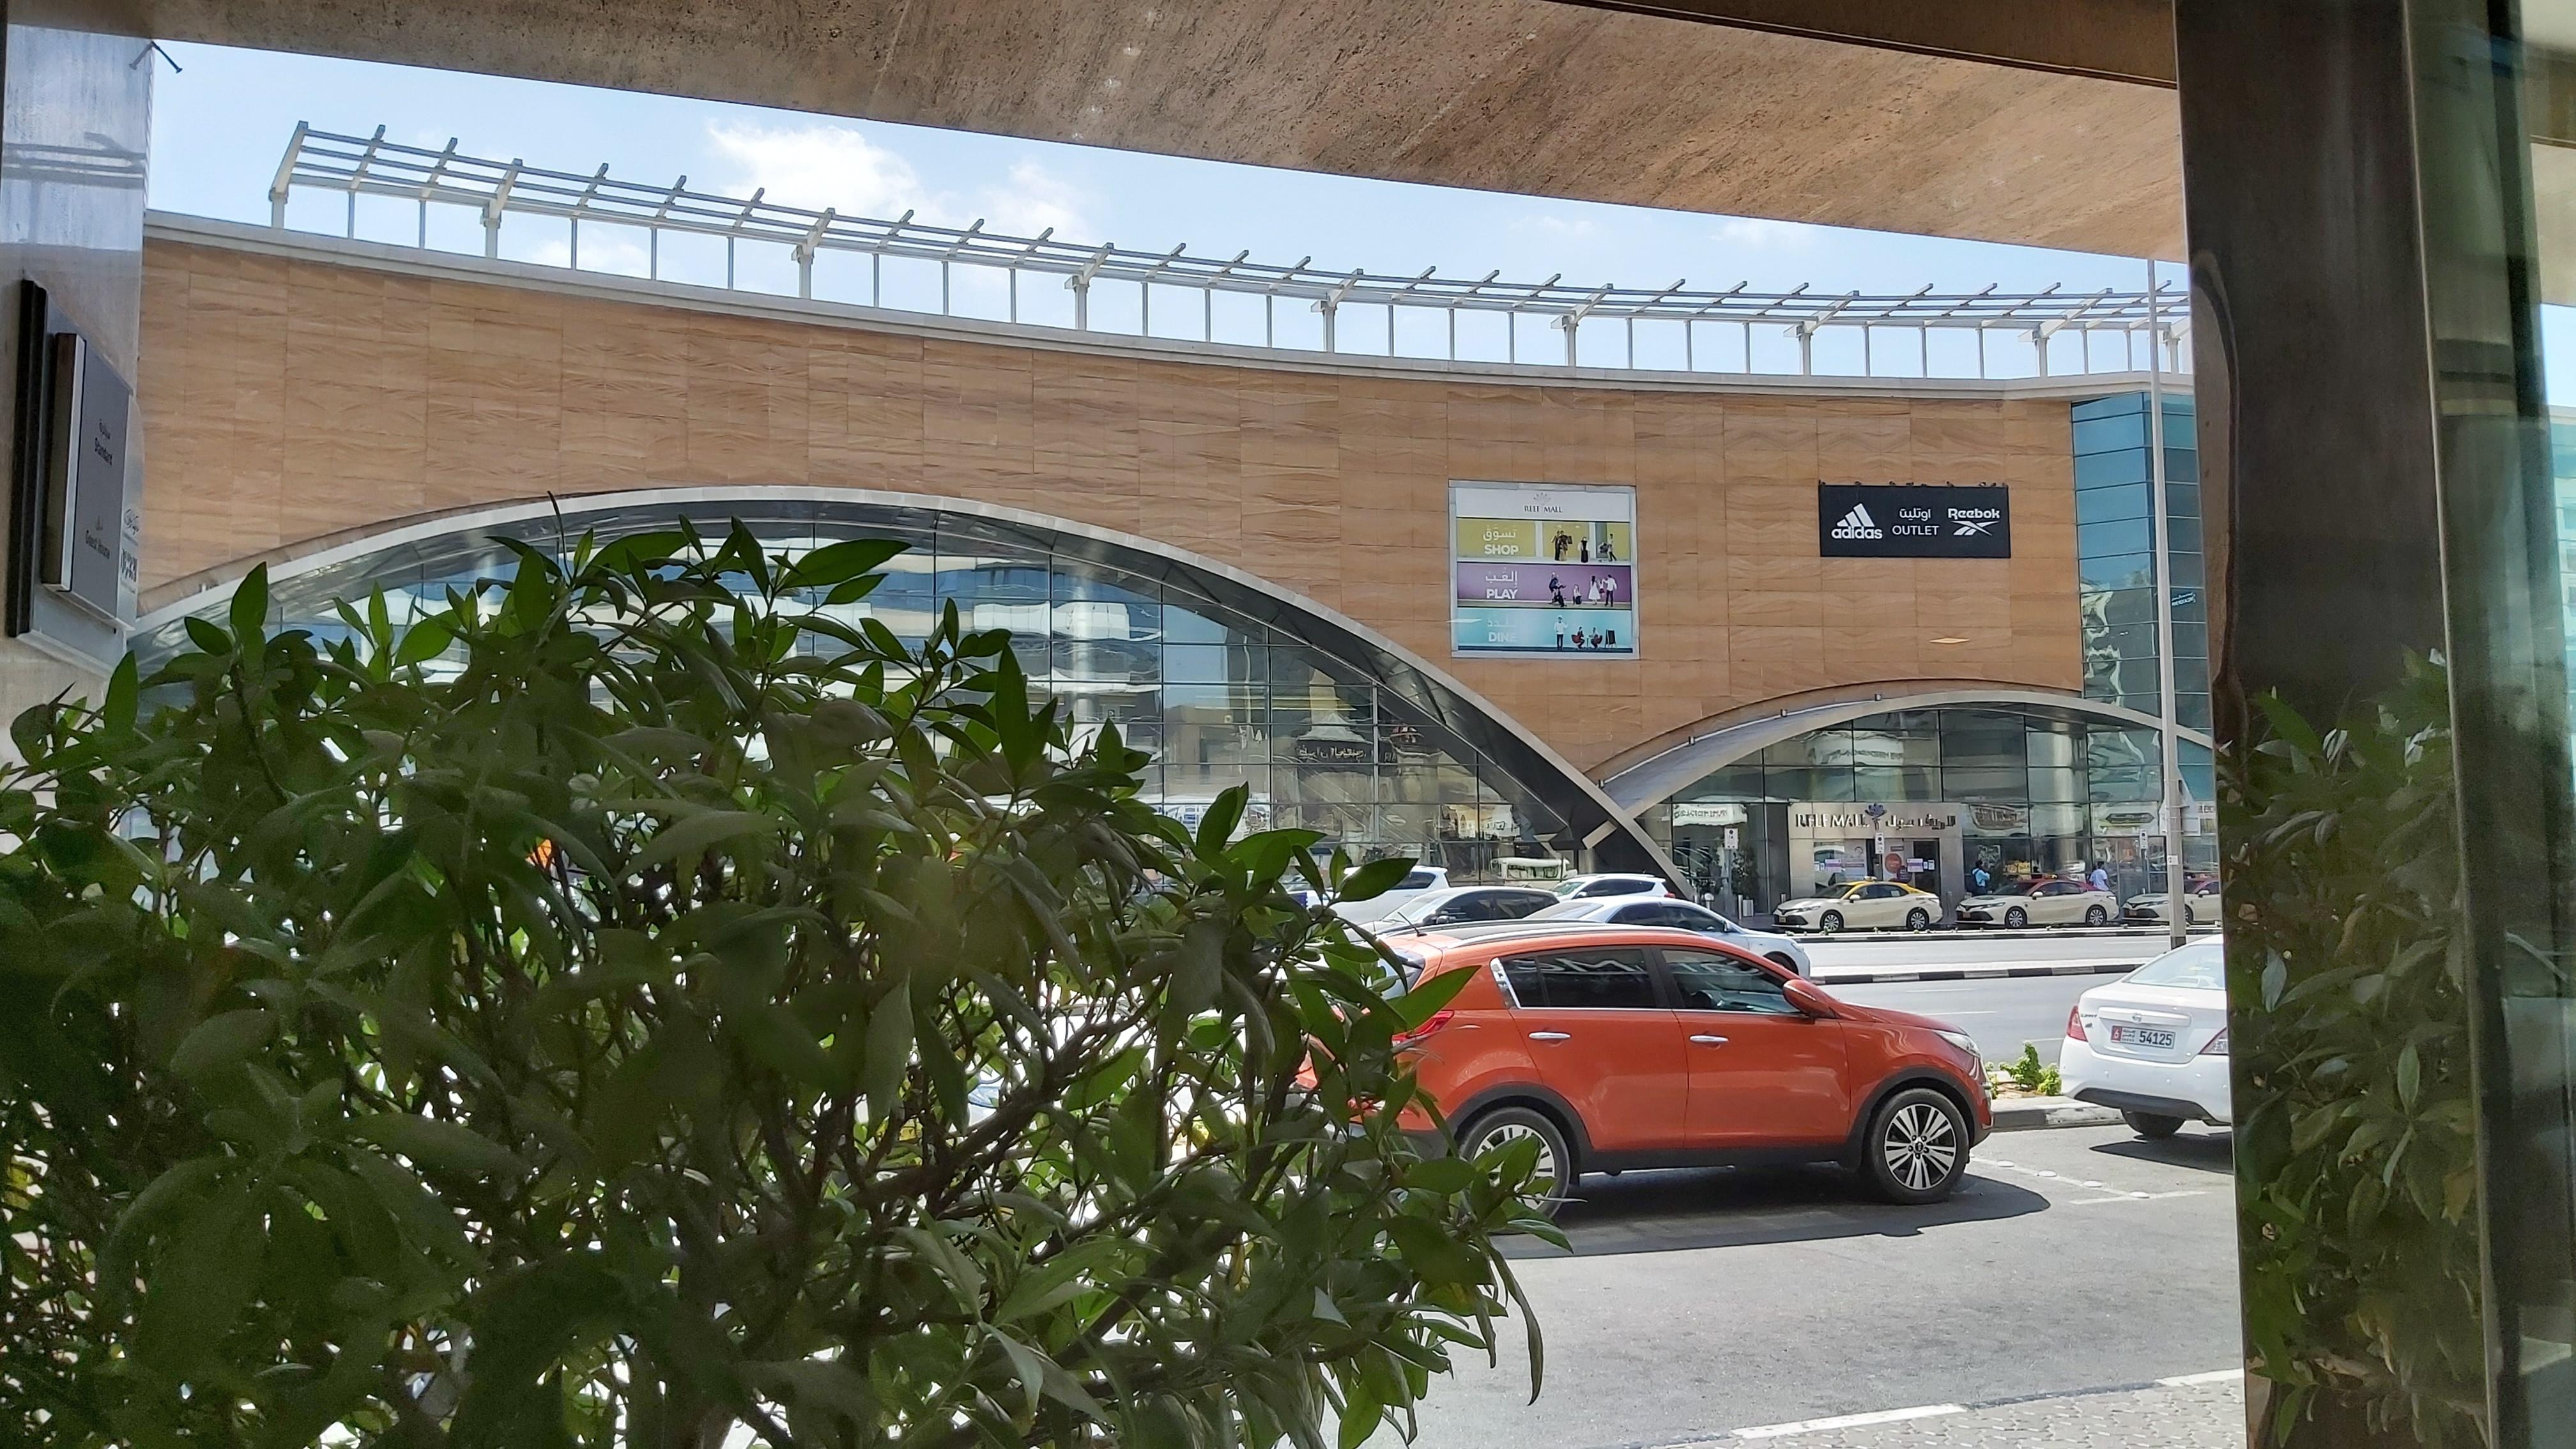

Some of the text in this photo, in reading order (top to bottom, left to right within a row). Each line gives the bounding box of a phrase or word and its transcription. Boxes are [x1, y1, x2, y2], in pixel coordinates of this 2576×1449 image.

[1947, 508, 2000, 519] Reebok
[1831, 526, 1883, 539] adidas
[1892, 525, 1940, 535] OUTLET
[1484, 544, 1519, 555] SHOP
[1486, 588, 1518, 599] PLAY
[1488, 631, 1518, 642] DINE
[1830, 814, 1870, 828] MALL
[2138, 1031, 2173, 1046] 54125
